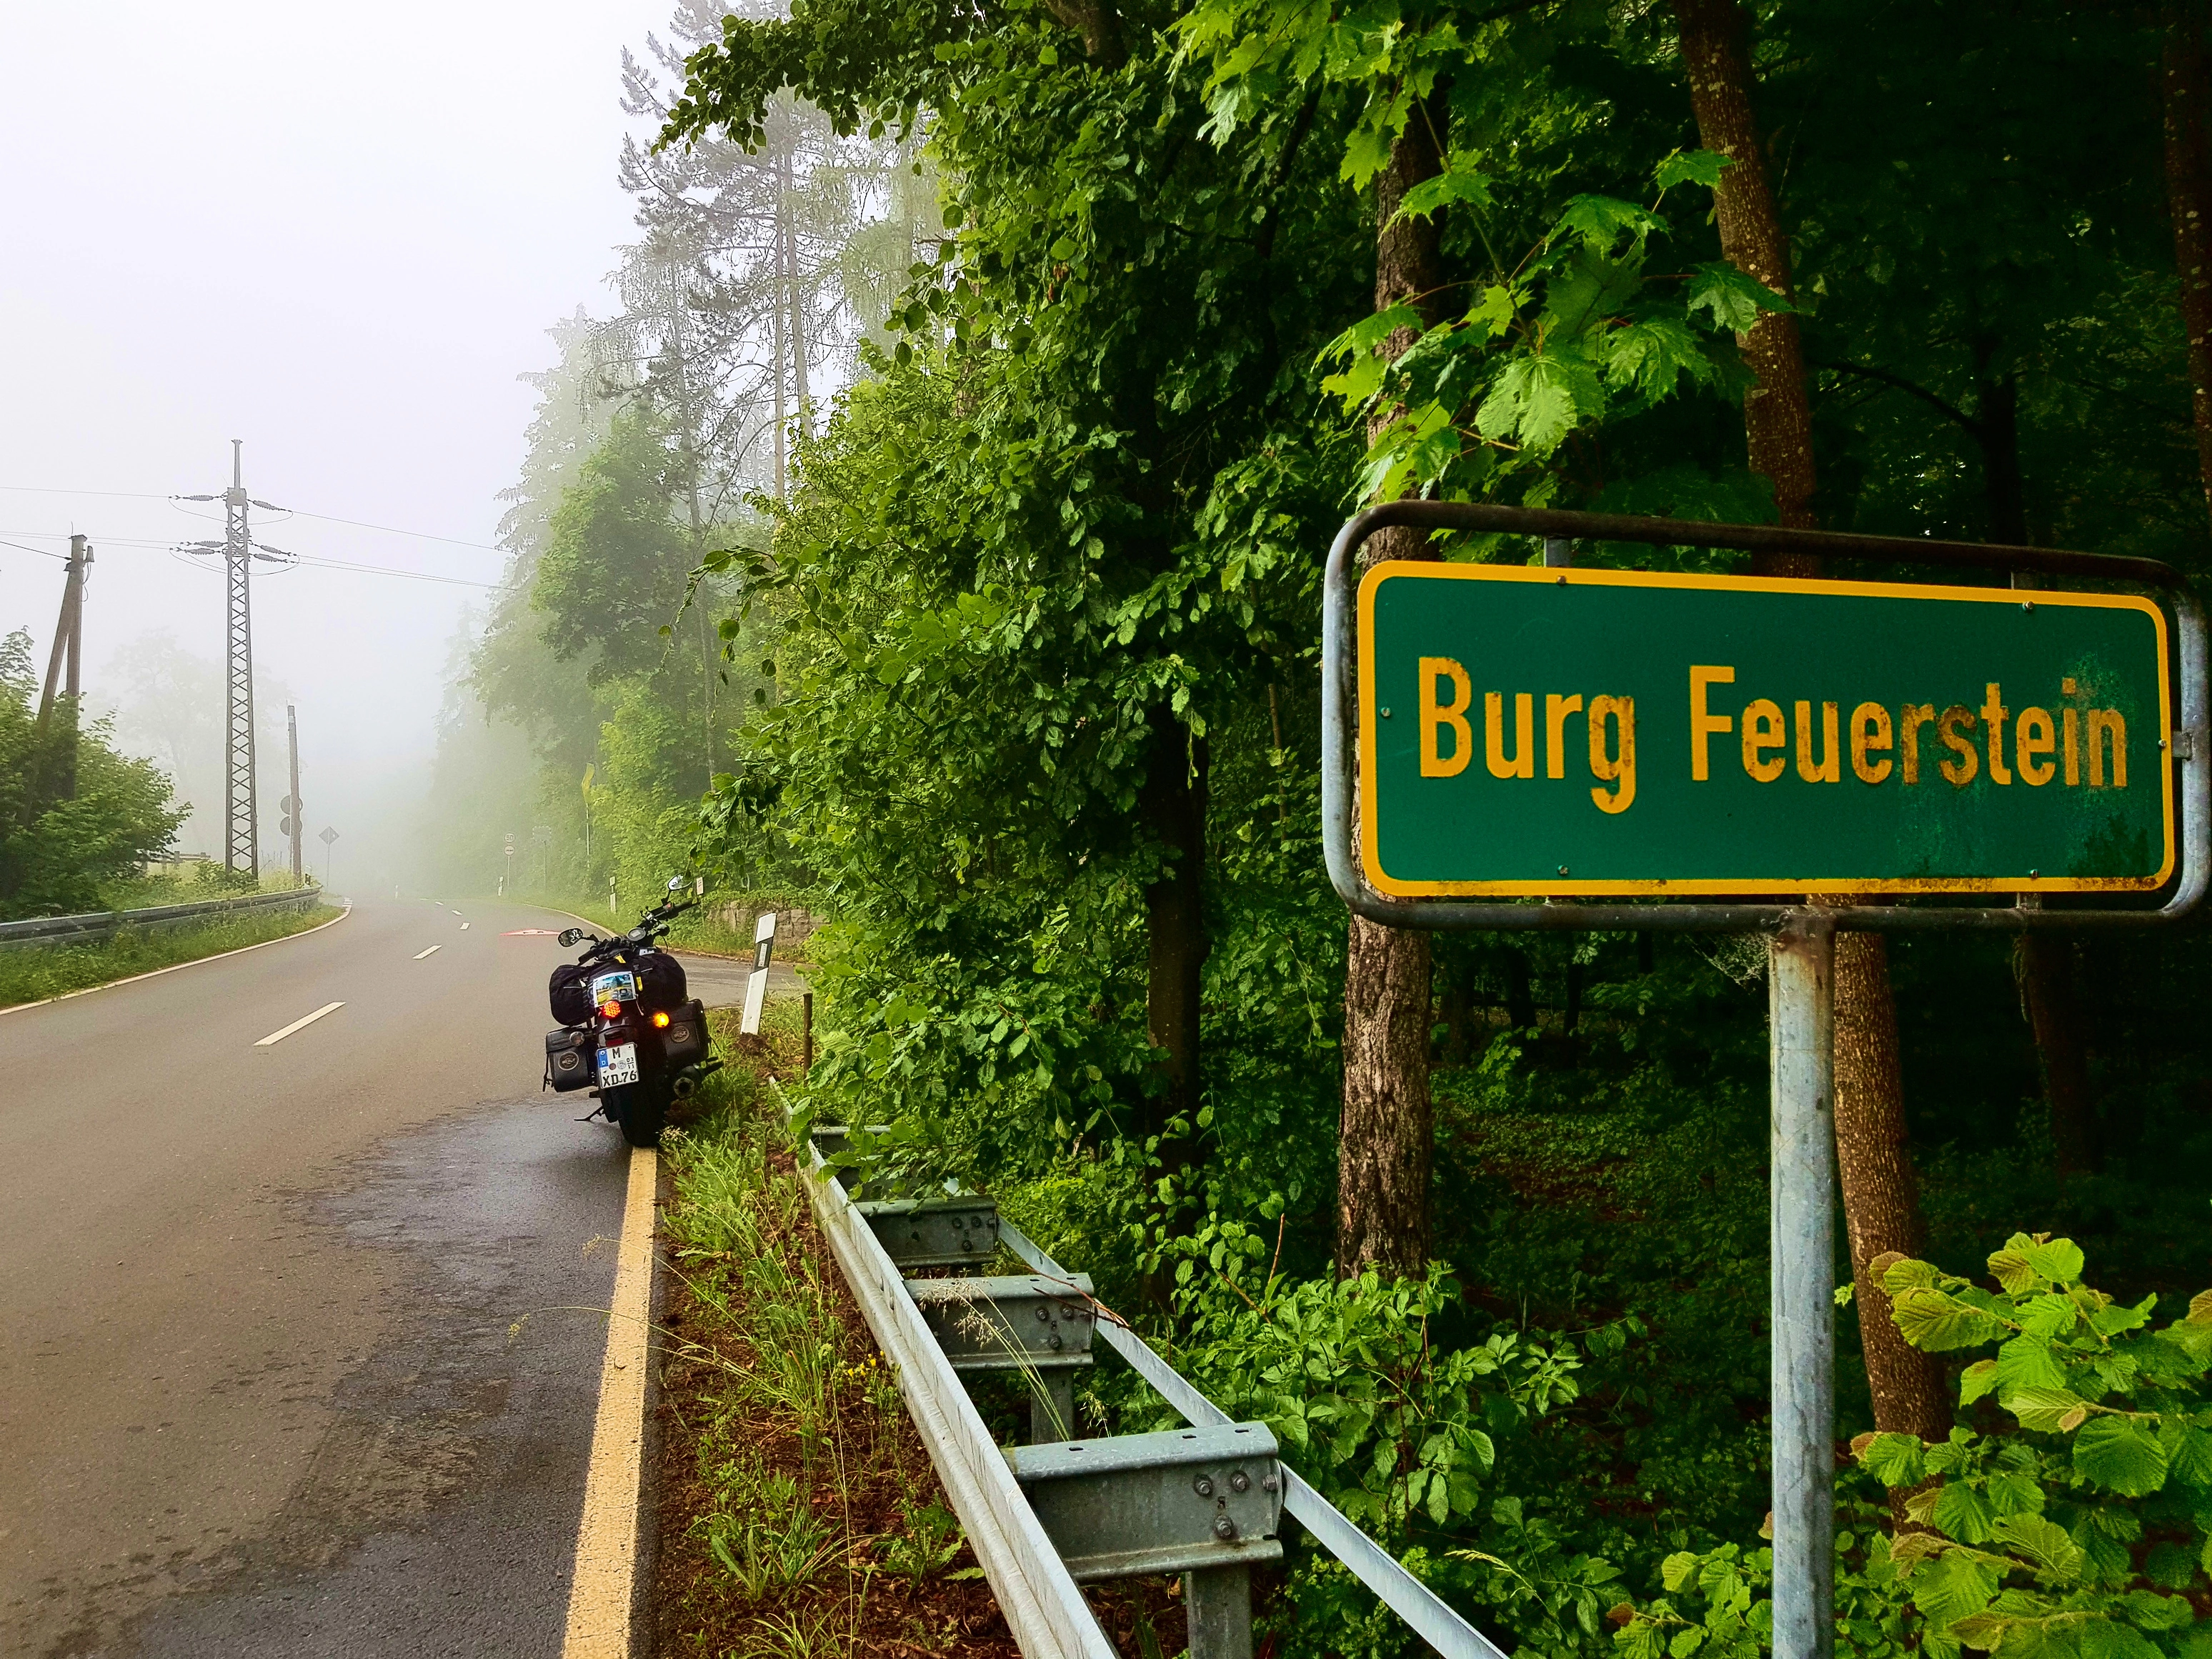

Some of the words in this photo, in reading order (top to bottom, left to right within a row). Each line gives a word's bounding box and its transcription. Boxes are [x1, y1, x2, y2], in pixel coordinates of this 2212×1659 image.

[1419, 657, 1636, 814] Burg
[1690, 665, 2128, 787] Feuerstein
[612, 1047, 620, 1059] M
[602, 1074, 619, 1087] XD
[622, 1070, 637, 1082] 76
